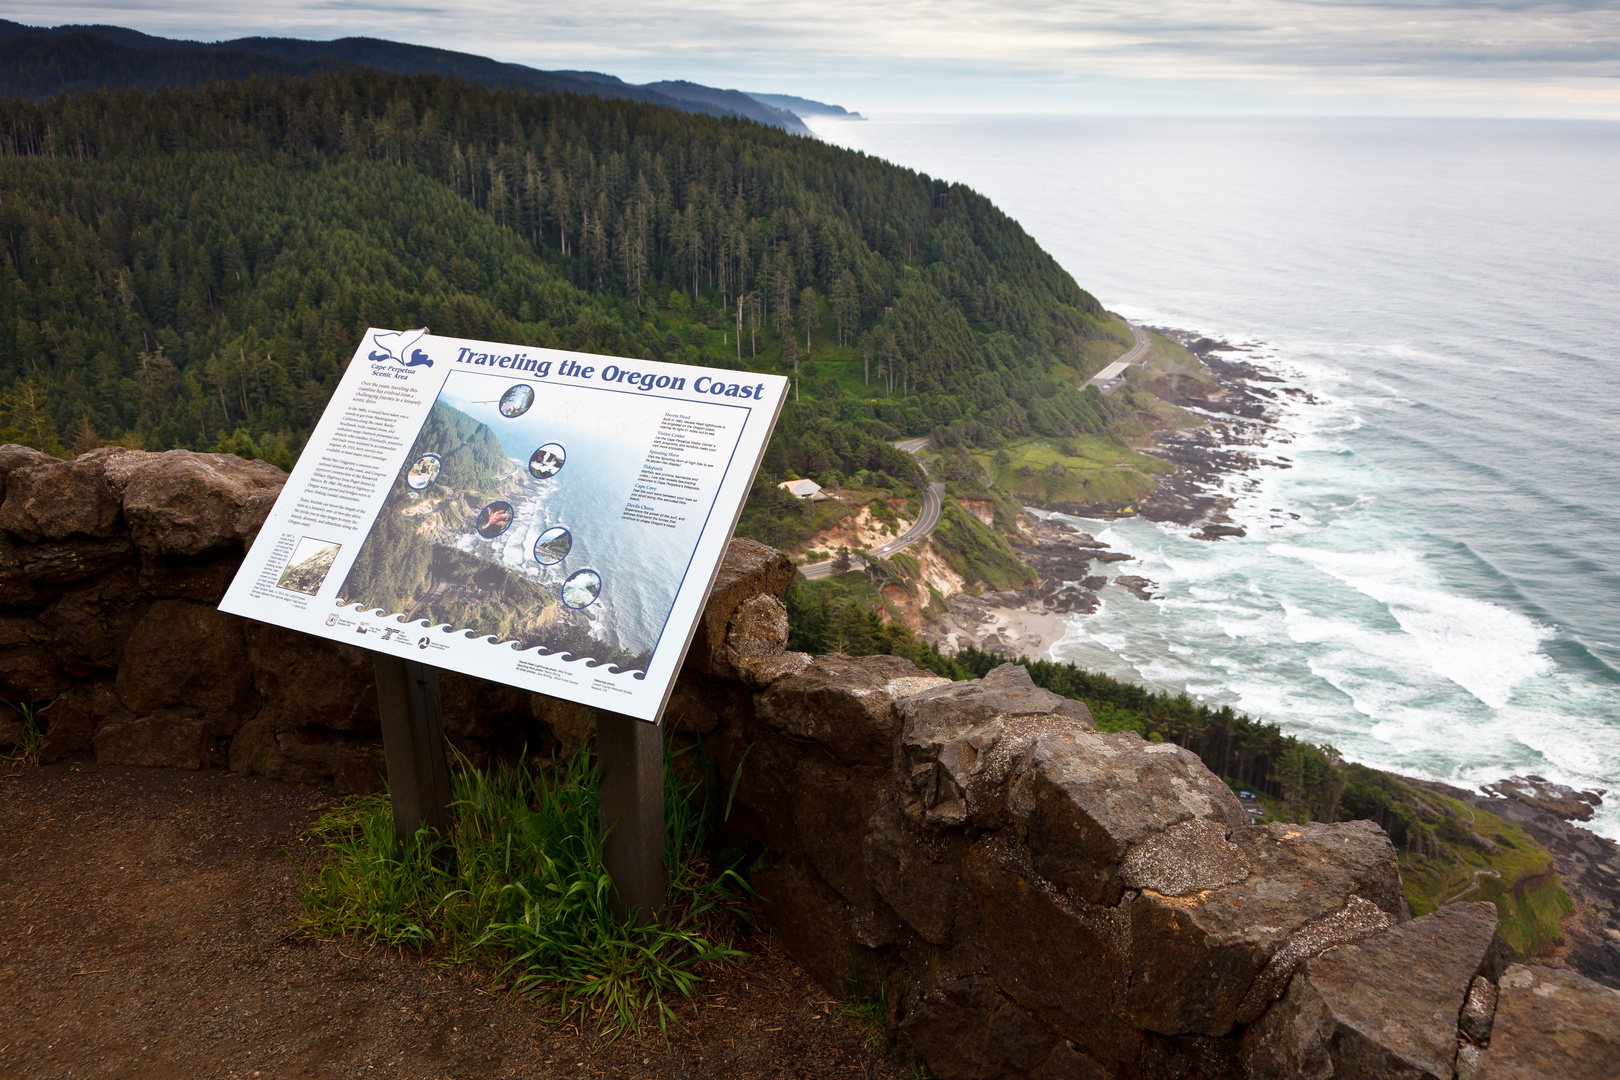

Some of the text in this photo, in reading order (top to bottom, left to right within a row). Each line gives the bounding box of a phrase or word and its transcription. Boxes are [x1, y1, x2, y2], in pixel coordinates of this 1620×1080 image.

[387, 366, 416, 374] Perpetua
[456, 347, 765, 400] Traveling the Oregon Coast
